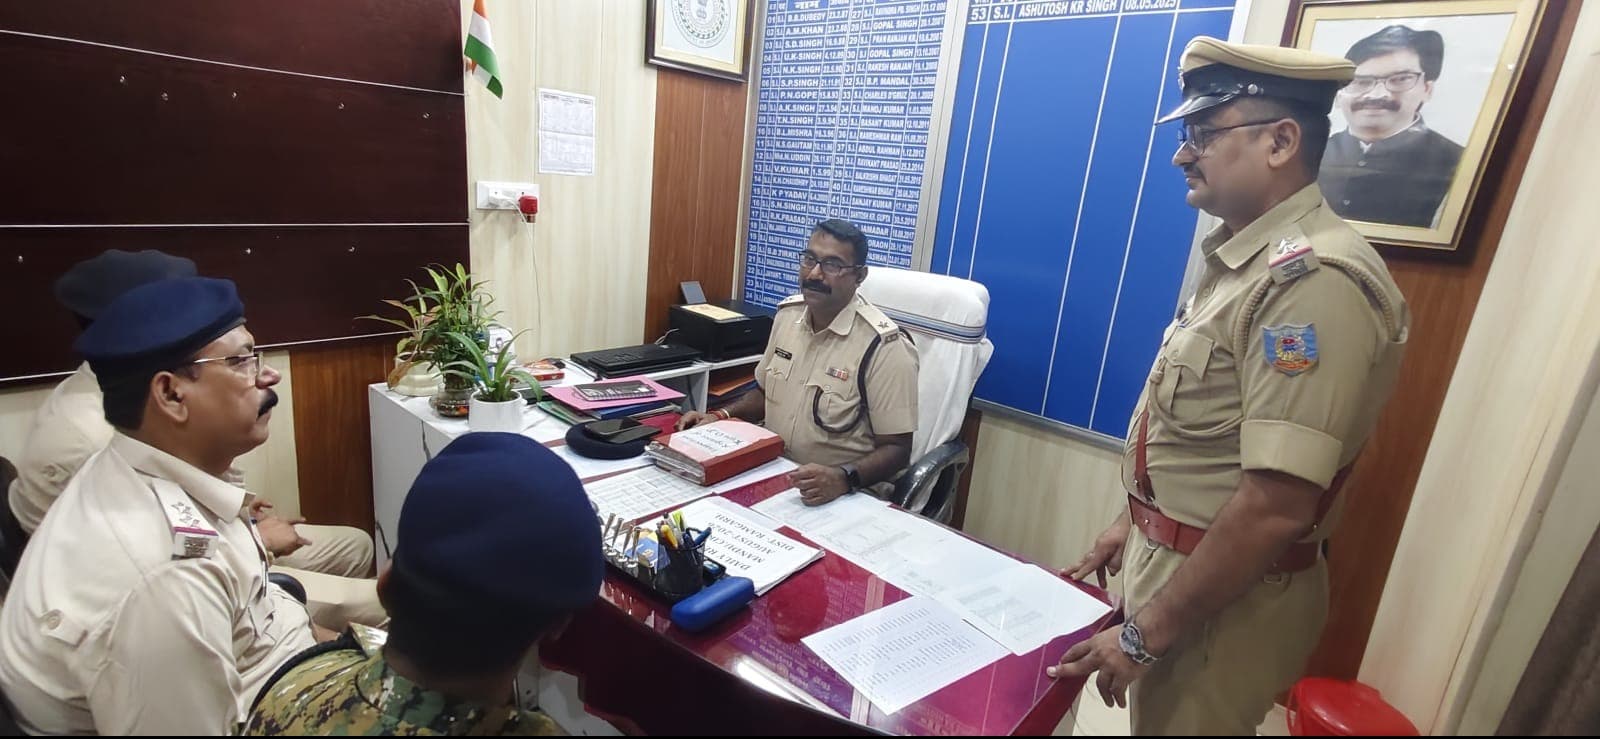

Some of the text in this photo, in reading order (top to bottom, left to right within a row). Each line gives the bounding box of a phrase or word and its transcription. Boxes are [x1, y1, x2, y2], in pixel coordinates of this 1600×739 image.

[971, 9, 986, 20] 53
[992, 8, 1010, 18] S.I.
[1018, 3, 1067, 17] ASHUTOSH
[1070, 2, 1084, 14] KR
[1085, 0, 1116, 12] SINGH
[873, 20, 894, 29] GOPAL
[896, 18, 918, 28] SINGH
[870, 48, 890, 58] GOPAL
[892, 48, 914, 57] SINGH
[844, 77, 853, 86] 32
[840, 104, 849, 113] 34
[840, 118, 848, 126] 35
[837, 143, 845, 152] 37
[774, 166, 810, 175] V.KUMAR
[832, 182, 840, 191] 40
[832, 196, 840, 205] 41
[830, 208, 838, 216] 42
[714, 512, 766, 539] RAMGARH
[718, 554, 751, 572] DAILY
